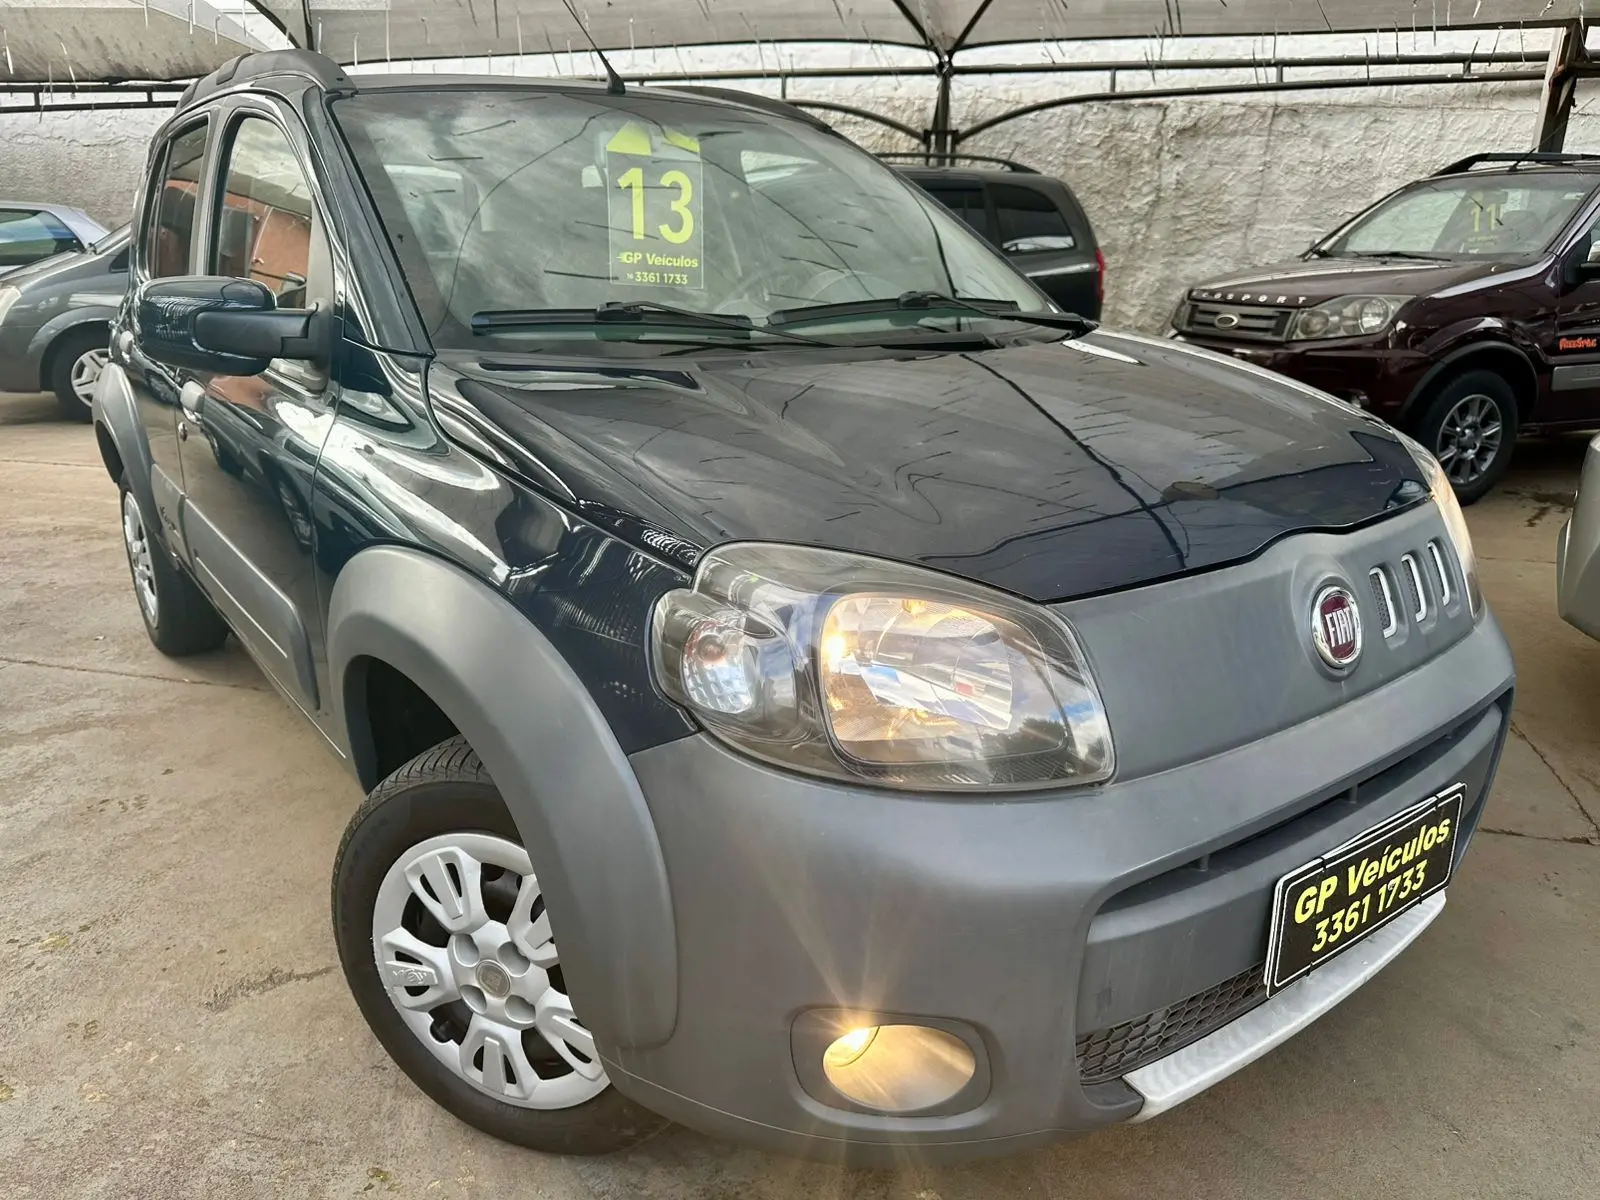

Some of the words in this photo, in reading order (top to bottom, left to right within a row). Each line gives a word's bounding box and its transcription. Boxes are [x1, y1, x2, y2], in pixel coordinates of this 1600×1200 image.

[616, 167, 695, 244] 13
[1471, 203, 1497, 232] 11
[623, 251, 643, 264] GP
[635, 271, 661, 283] 3361
[663, 272, 688, 285] 1733
[1324, 606, 1354, 648] FIAT
[1294, 875, 1338, 924] GP
[1347, 818, 1451, 897] Veículos
[1311, 893, 1371, 953] 3361
[1377, 859, 1428, 914] 1733
